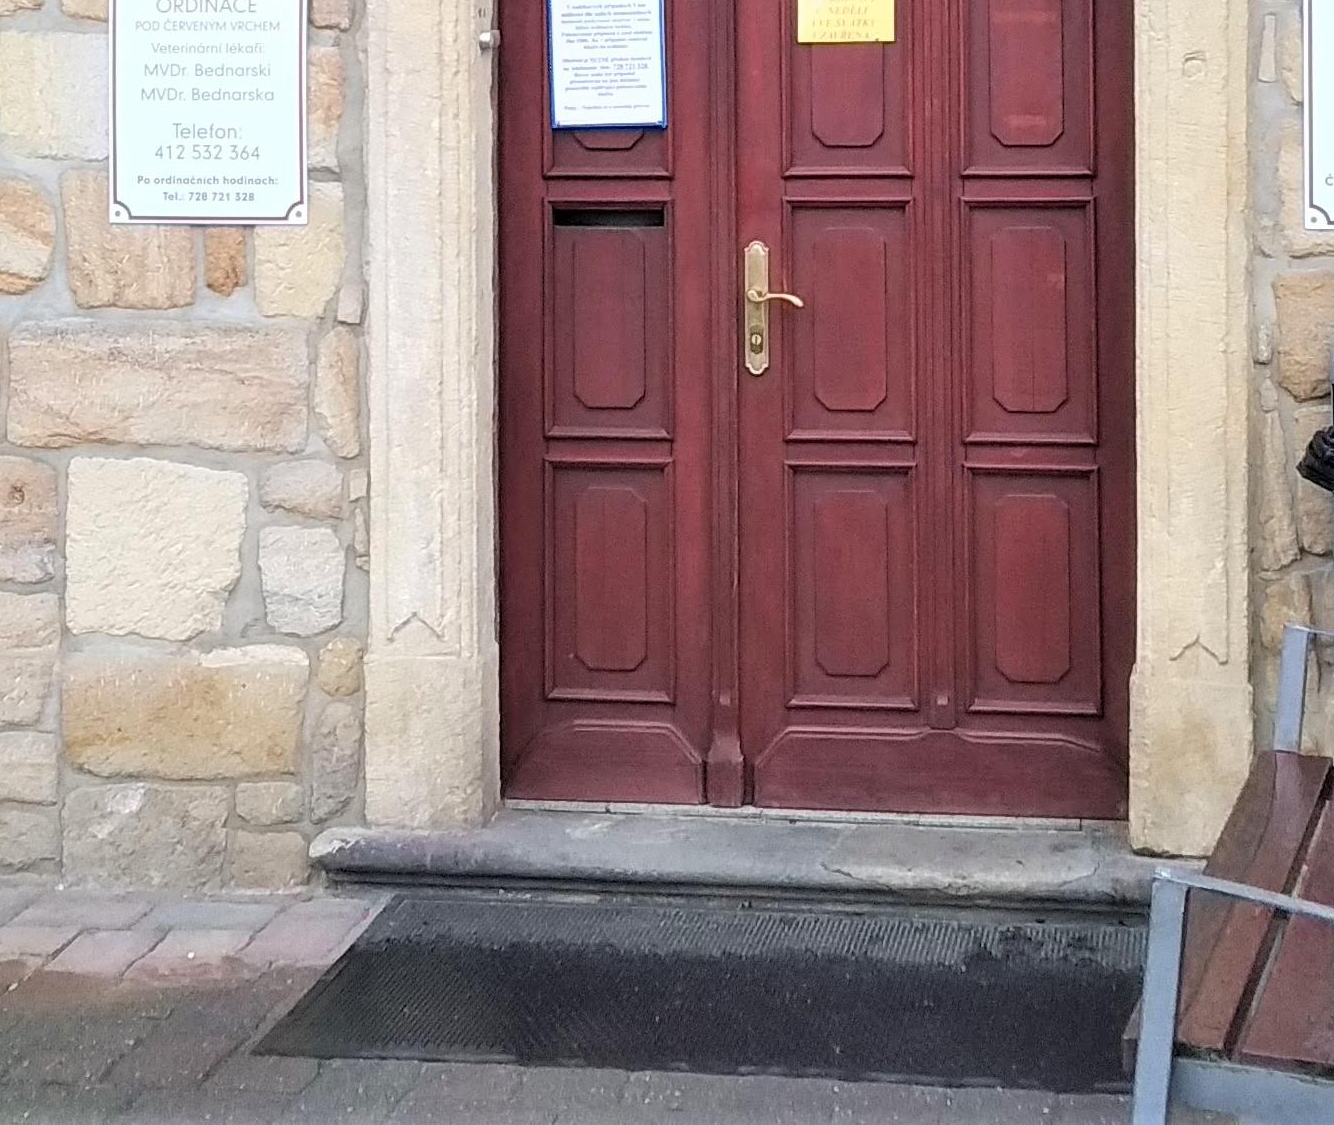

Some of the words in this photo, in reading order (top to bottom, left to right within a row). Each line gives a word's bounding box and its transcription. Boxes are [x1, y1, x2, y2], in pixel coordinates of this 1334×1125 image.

[135, 20, 160, 32] POD
[230, 20, 281, 32] VRCHEM
[150, 42, 222, 54] Veterinární
[194, 63, 271, 77] Bednarski
[140, 87, 186, 101] MVDr.
[191, 87, 275, 101] Bednarska
[172, 122, 242, 140] Telefon:
[154, 144, 185, 160] 412
[191, 144, 223, 160] 532
[229, 144, 260, 161] 364
[137, 175, 151, 185] Po
[153, 175, 219, 185] ordinačních
[188, 191, 208, 201] 728
[212, 191, 230, 201] 721
[235, 191, 255, 202] 328
